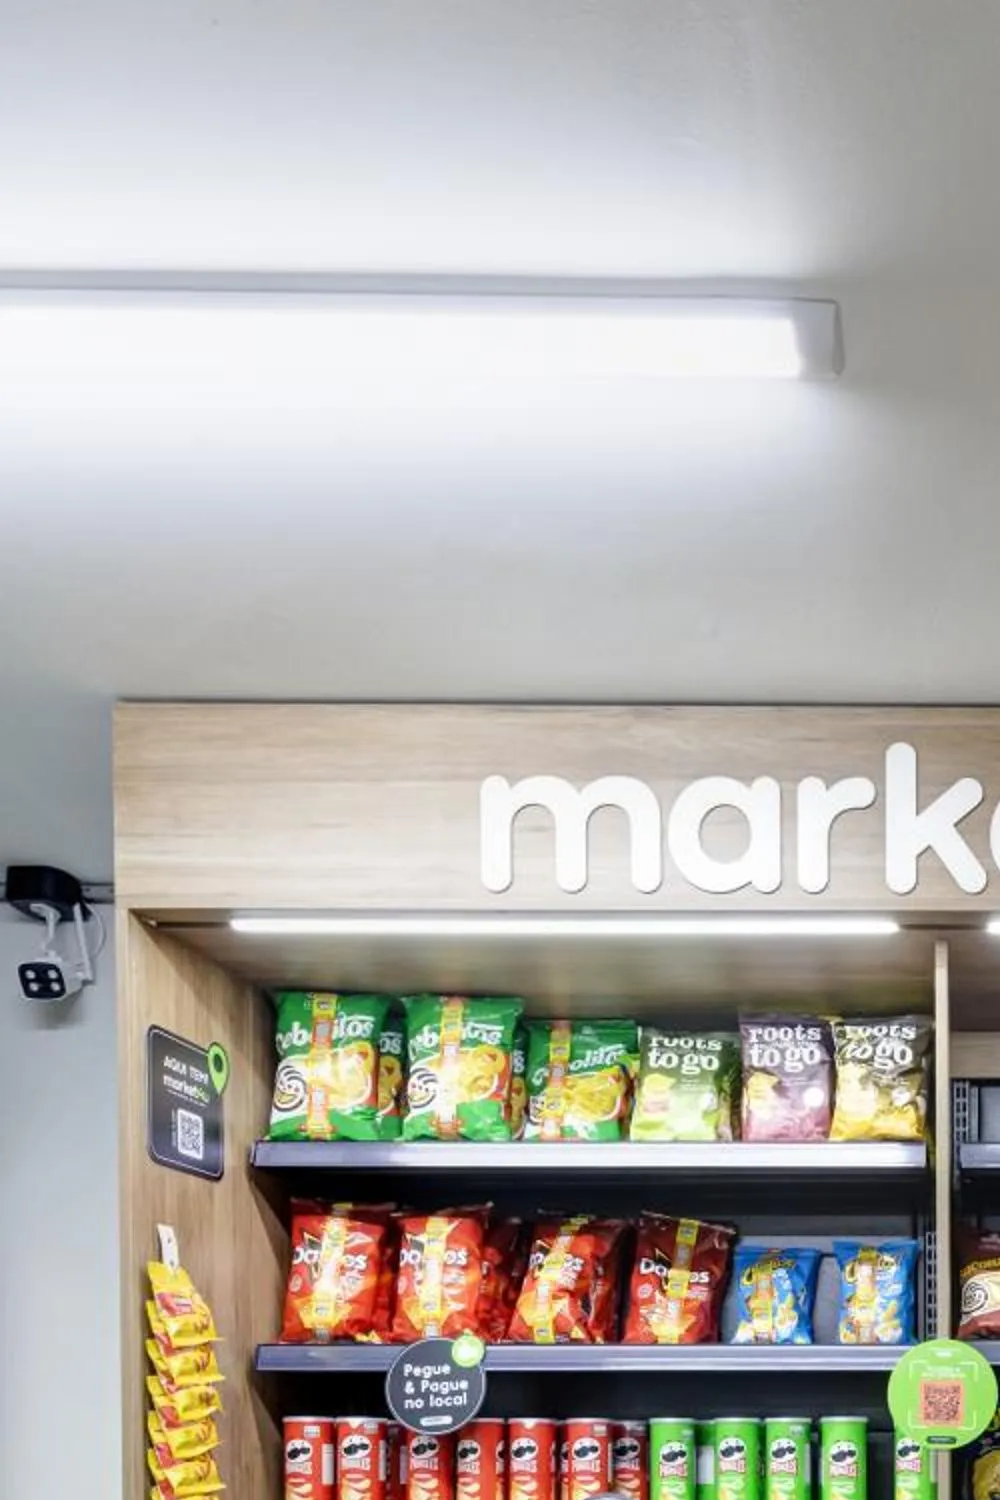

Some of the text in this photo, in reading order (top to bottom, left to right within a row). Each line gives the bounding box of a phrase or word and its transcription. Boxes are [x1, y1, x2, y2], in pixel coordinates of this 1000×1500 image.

[748, 1024, 822, 1043] roots
[845, 1024, 917, 1042] roots
[649, 1036, 723, 1052] roots
[648, 1050, 719, 1075] to go
[749, 1043, 821, 1073] to go
[845, 1040, 914, 1069] to go
[403, 1363, 451, 1379] Pegue
[404, 1379, 469, 1395] & Pague
[404, 1391, 467, 1409] no local
